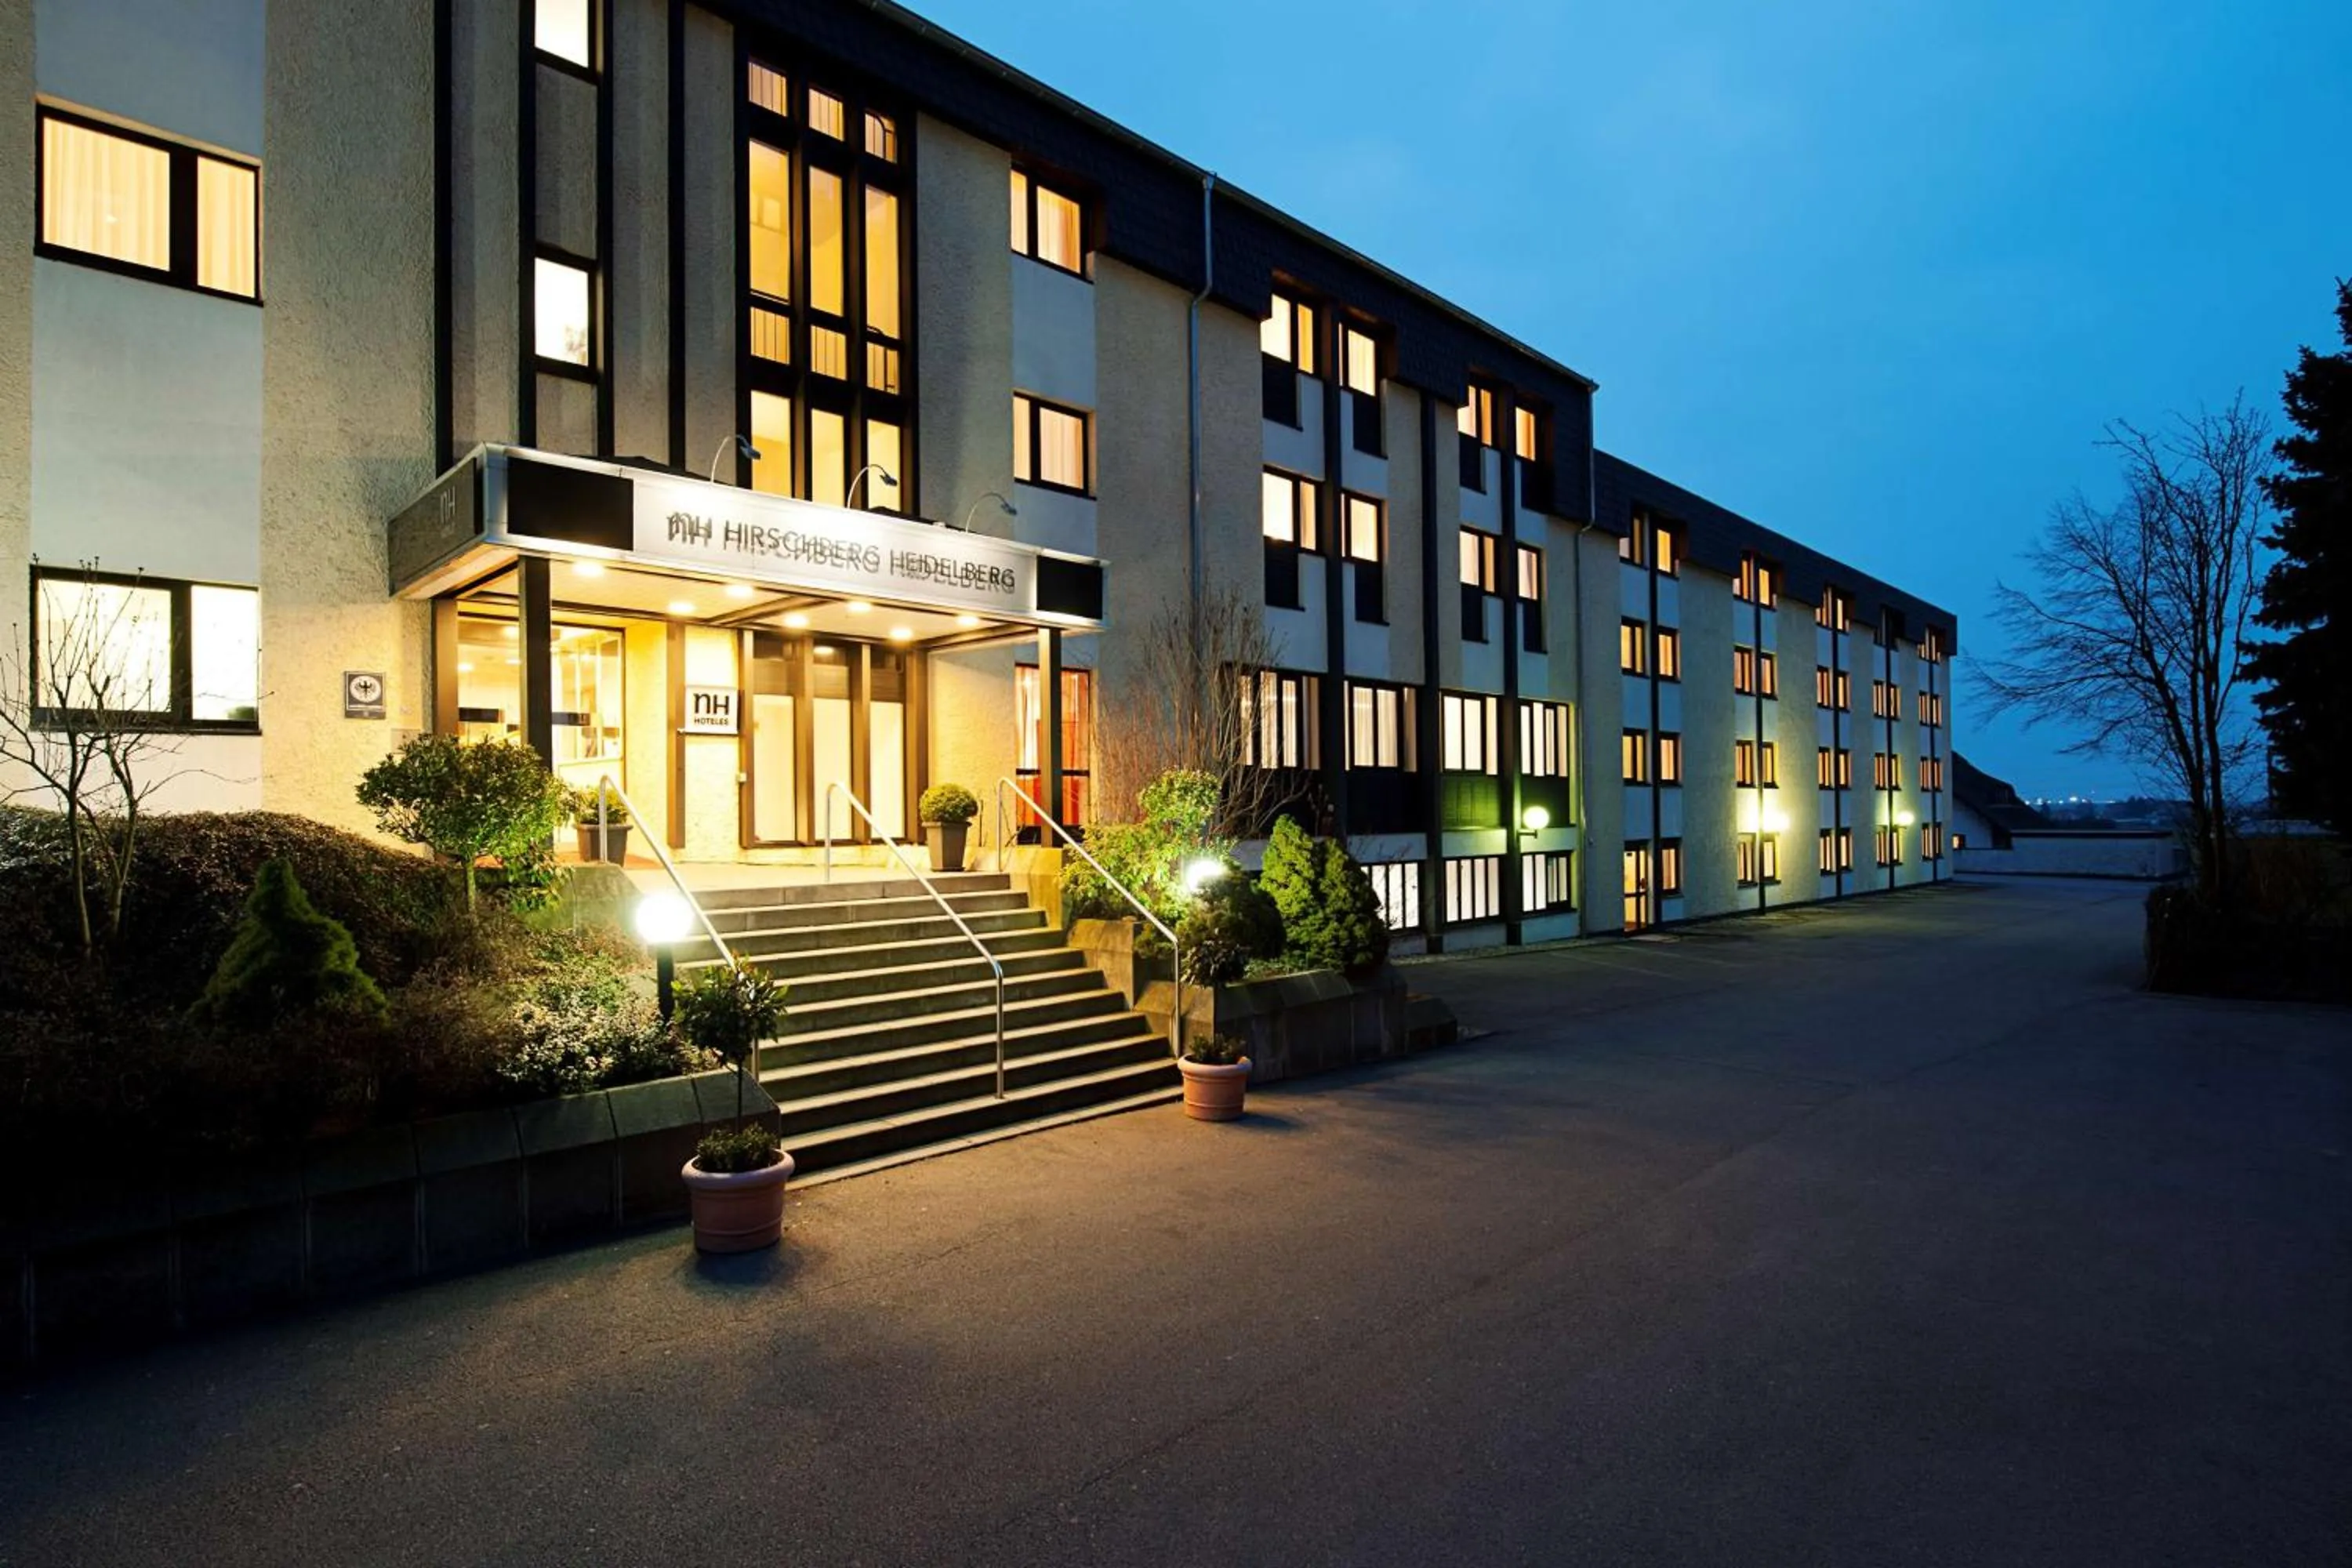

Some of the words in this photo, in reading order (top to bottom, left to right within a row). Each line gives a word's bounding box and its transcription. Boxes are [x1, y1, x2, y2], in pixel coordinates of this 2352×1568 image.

[724, 520, 880, 573] HIRSCHBERG
[890, 548, 1015, 594] HEIDELBERG
[694, 717, 729, 726] HOTELES
